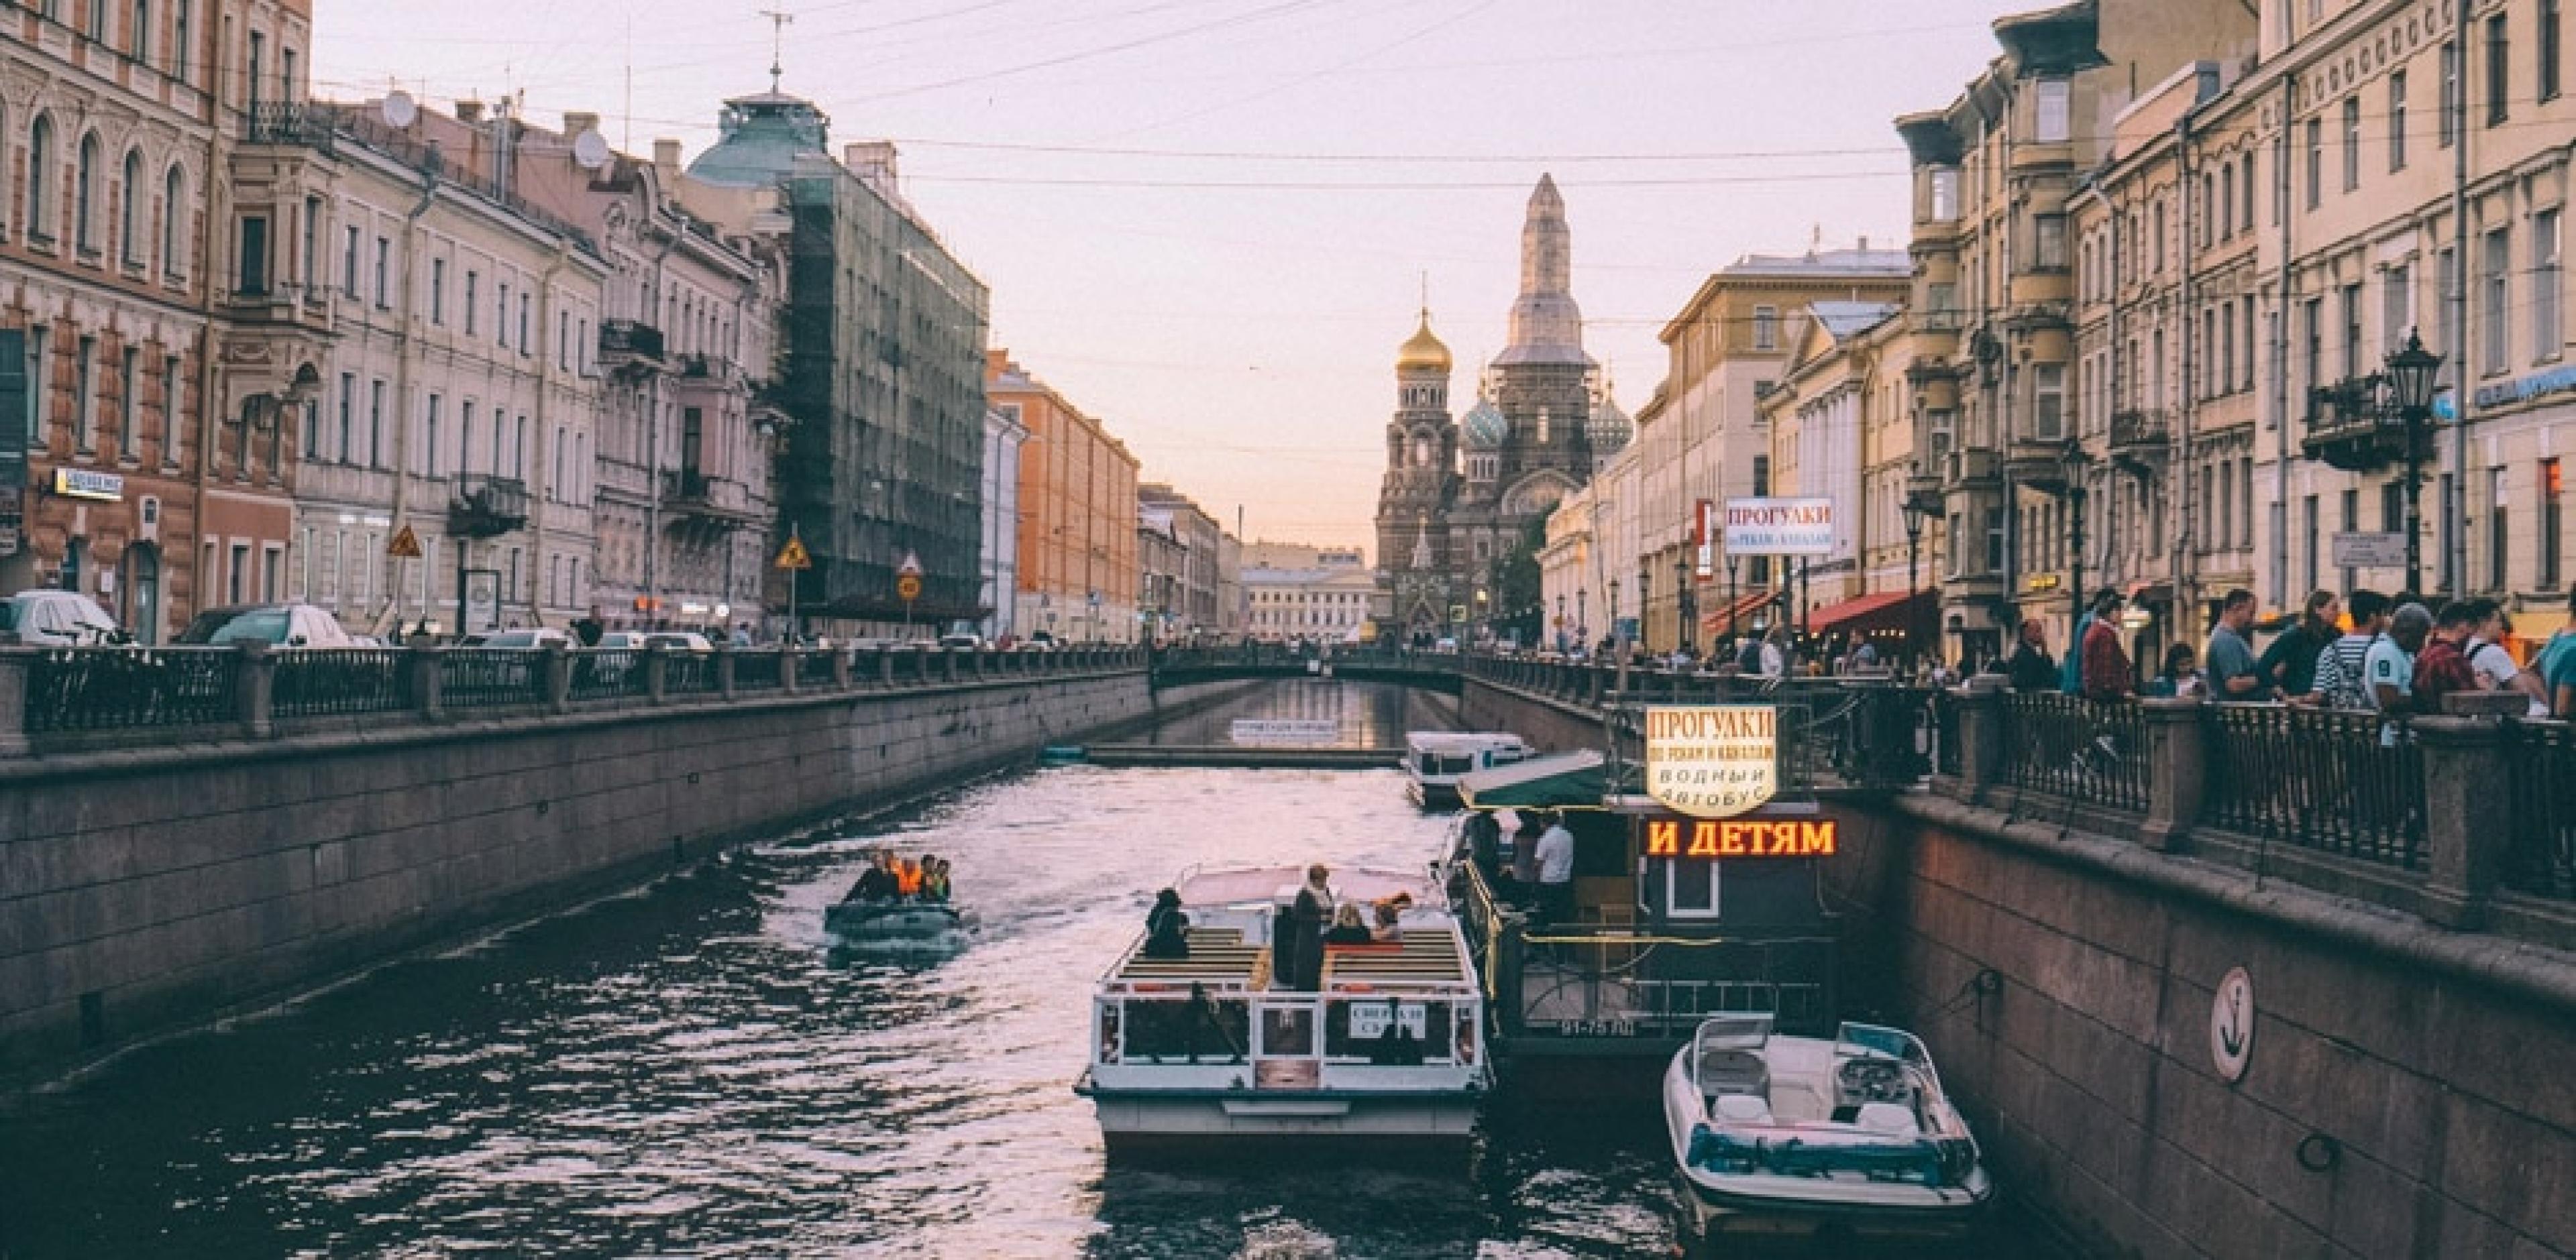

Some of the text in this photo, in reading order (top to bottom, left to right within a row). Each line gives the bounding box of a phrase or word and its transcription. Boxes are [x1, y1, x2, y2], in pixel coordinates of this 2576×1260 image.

[1728, 506, 1831, 526] ПРОГУЛКИ
[1648, 711, 1772, 738] ПРОГУЛКИ
[1661, 786, 1765, 807] АВТОБУС
[1648, 821, 1835, 856] И ДЕТЯМ
